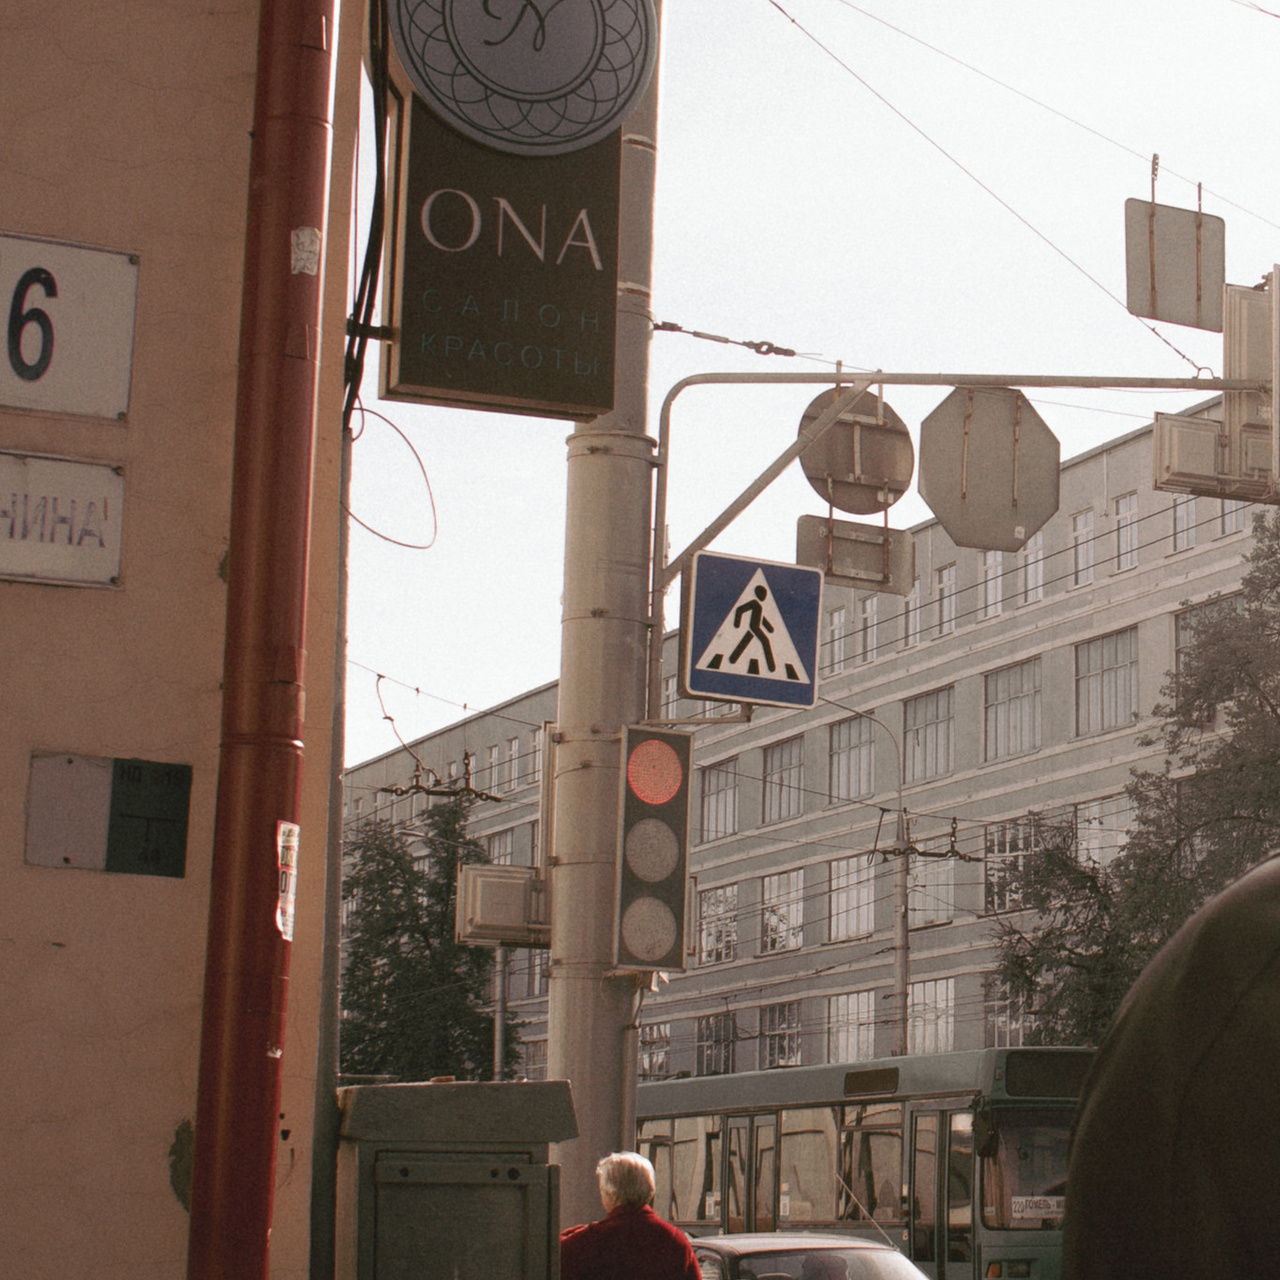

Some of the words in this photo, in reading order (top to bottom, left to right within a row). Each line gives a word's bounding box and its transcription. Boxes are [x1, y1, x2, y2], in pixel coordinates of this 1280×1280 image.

[420, 188, 604, 271] ONA
[7, 266, 59, 383] 6
[421, 288, 601, 332] САЛОН
[420, 332, 599, 376] КРАСОТЫ
